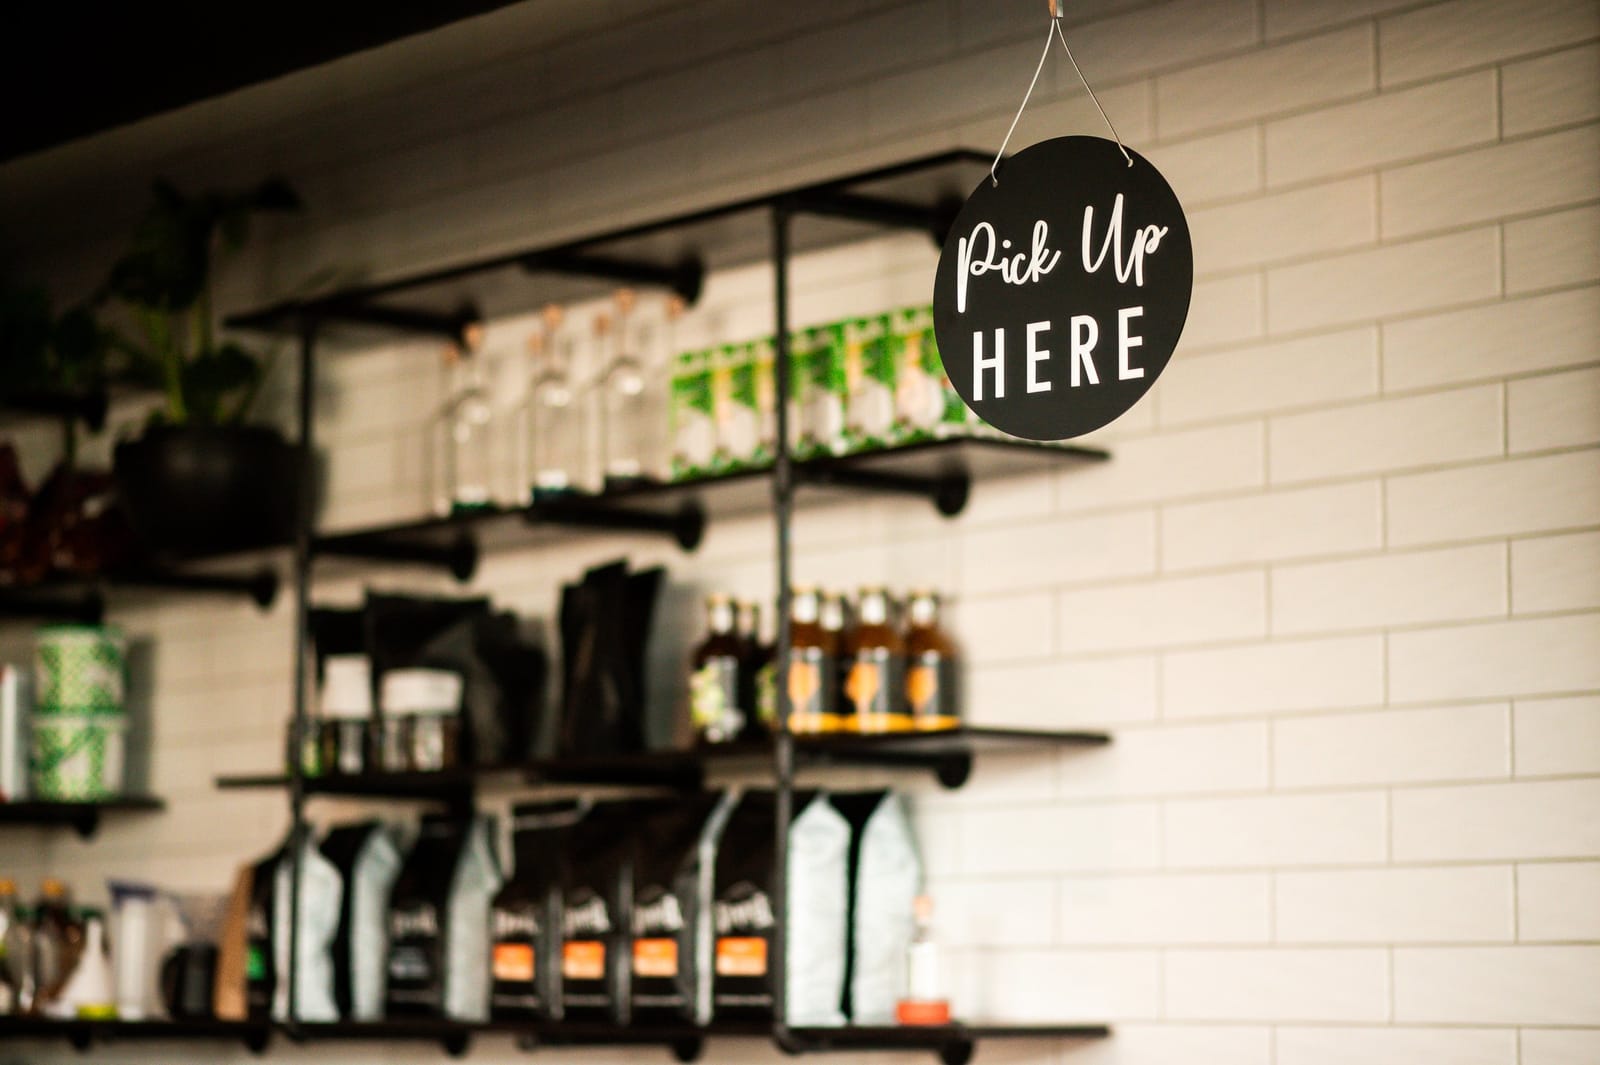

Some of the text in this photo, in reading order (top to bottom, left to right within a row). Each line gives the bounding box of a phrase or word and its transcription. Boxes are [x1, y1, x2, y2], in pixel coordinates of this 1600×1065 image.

[957, 193, 1168, 313] Pick Up
[973, 306, 1145, 401] HERE
